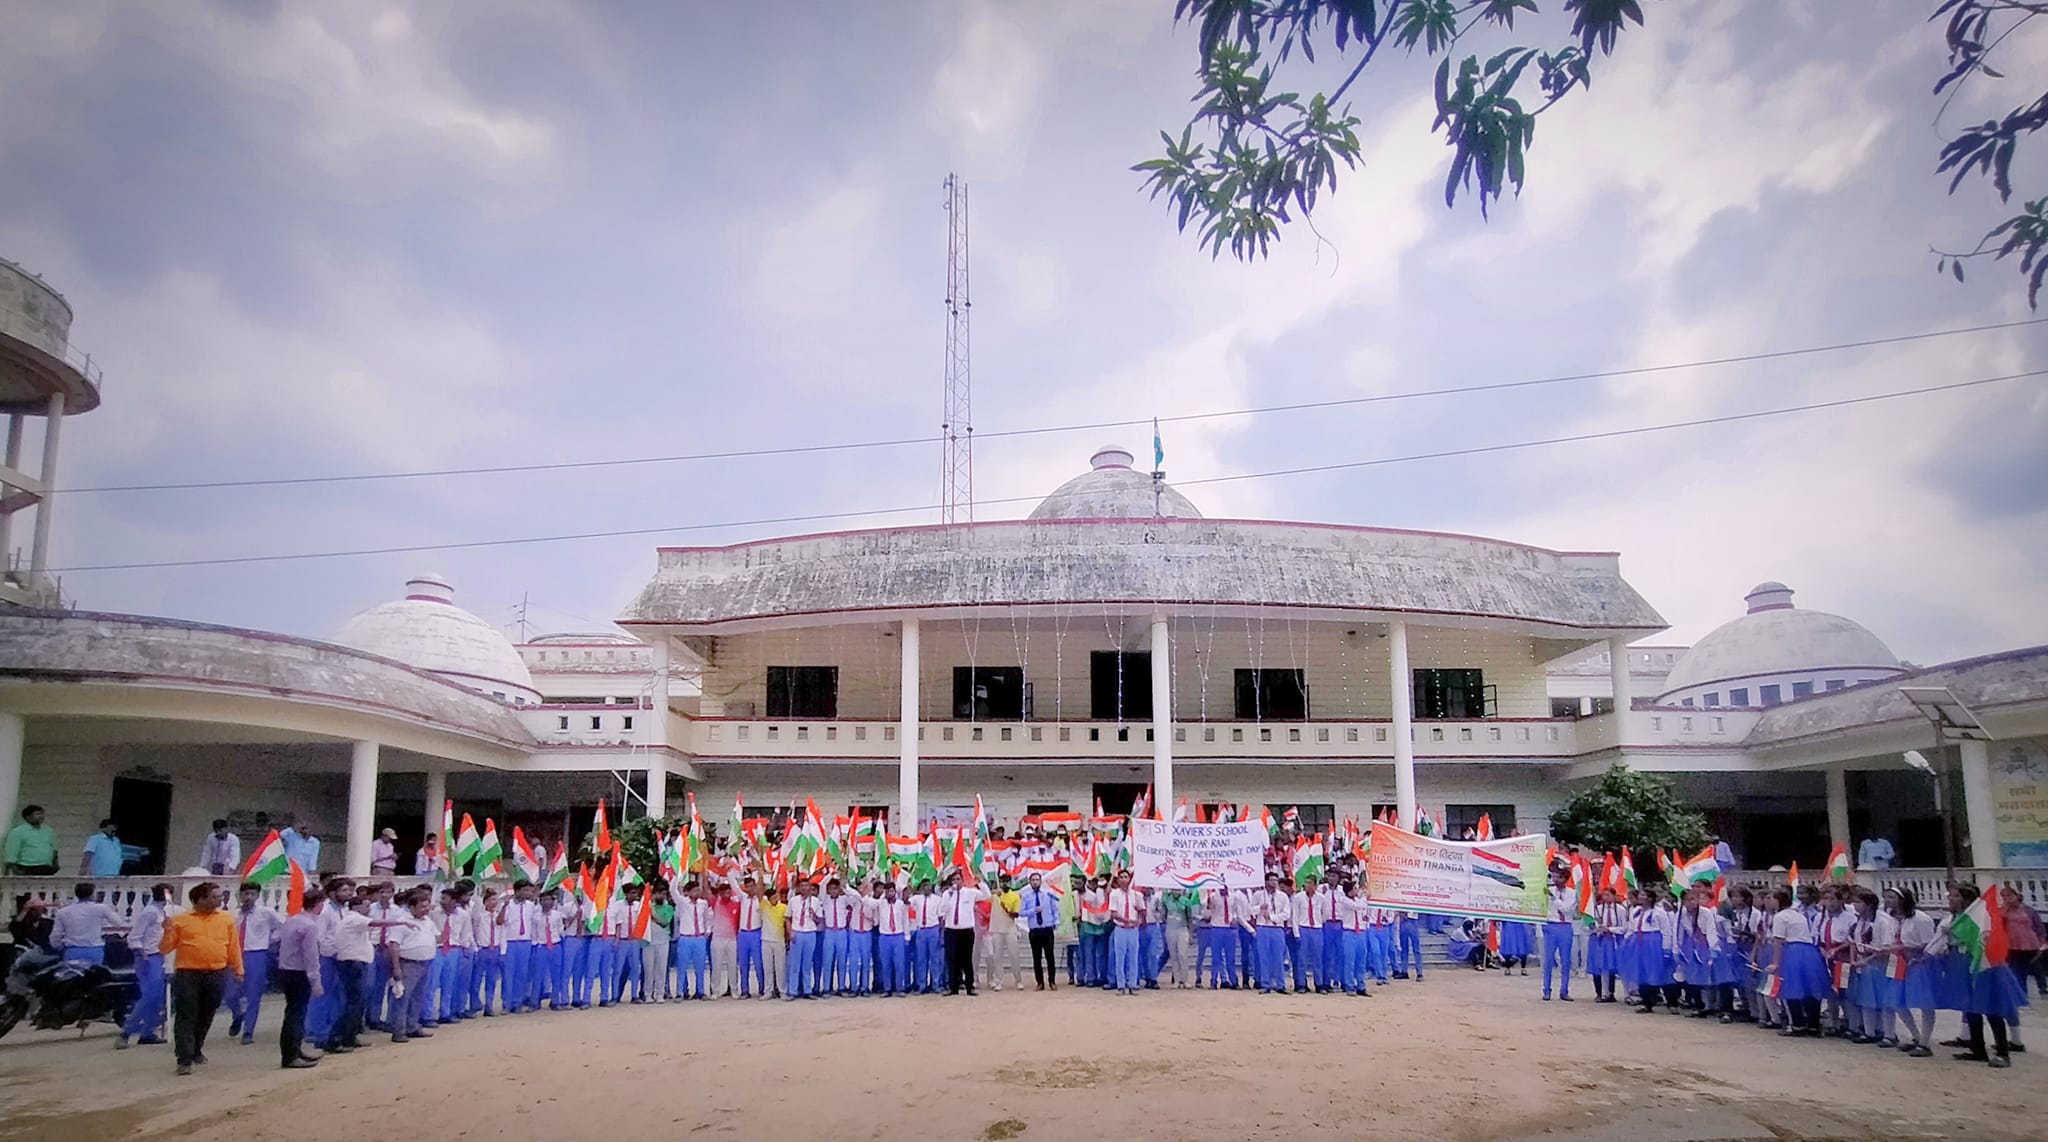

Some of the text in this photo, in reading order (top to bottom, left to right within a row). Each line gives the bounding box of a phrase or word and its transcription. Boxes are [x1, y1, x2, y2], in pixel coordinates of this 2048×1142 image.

[1154, 823, 1248, 837] ST XAVIER'S SCHOOL
[1246, 845, 1261, 854] DAY
[1374, 853, 1465, 873] HAR GHAR TIRANGA
